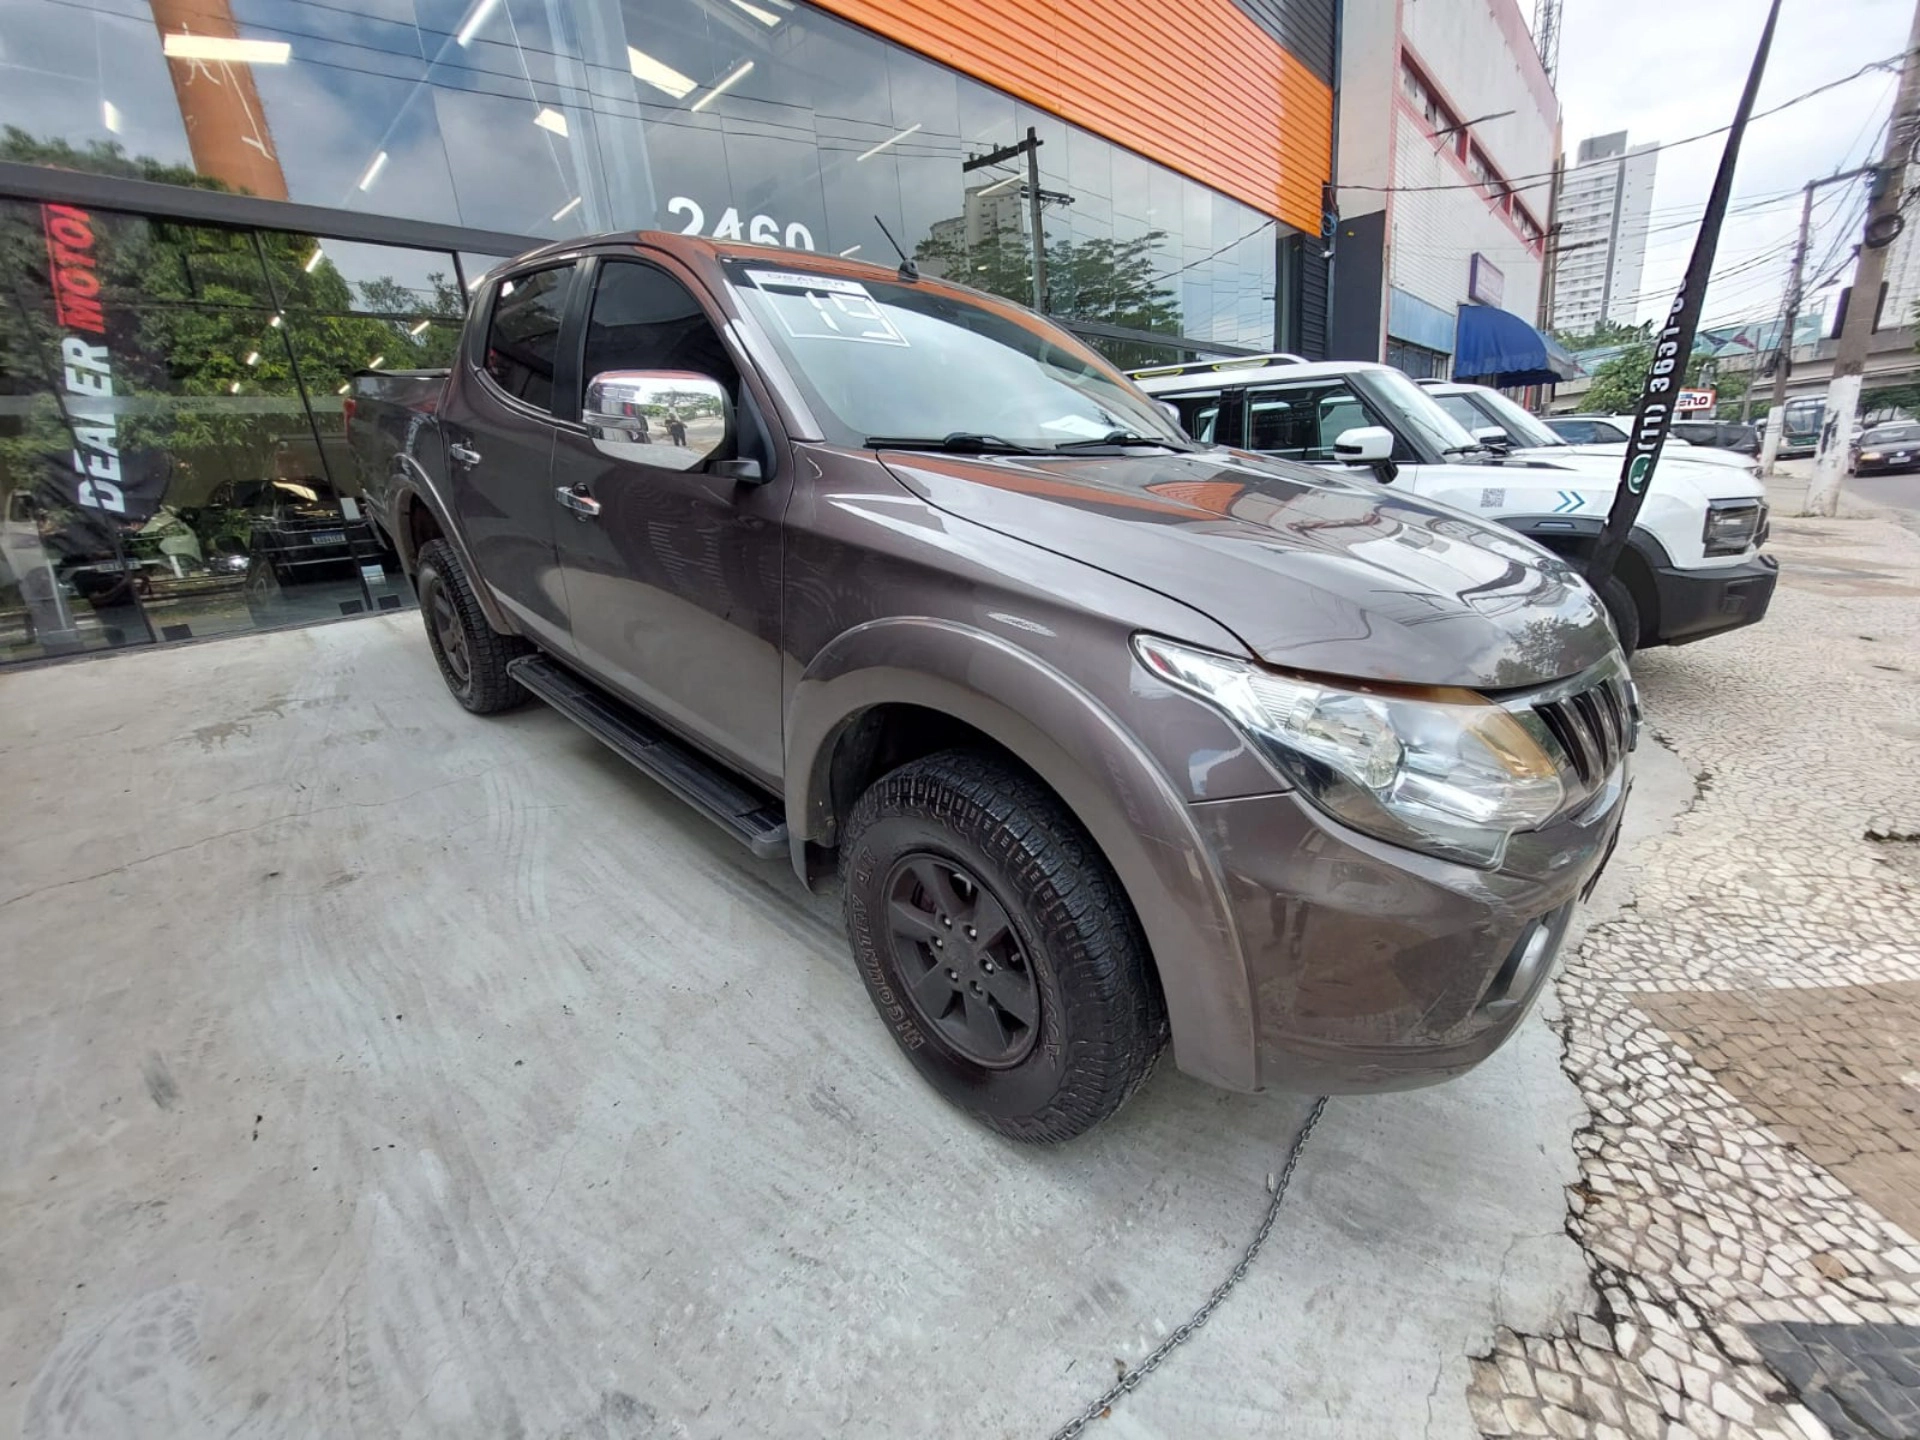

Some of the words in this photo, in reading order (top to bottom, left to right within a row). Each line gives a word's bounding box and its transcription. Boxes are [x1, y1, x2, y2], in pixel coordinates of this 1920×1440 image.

[668, 196, 815, 252] 2460
[47, 204, 106, 333] MOTO
[805, 290, 900, 340] 19
[1637, 404, 1667, 450] (11)
